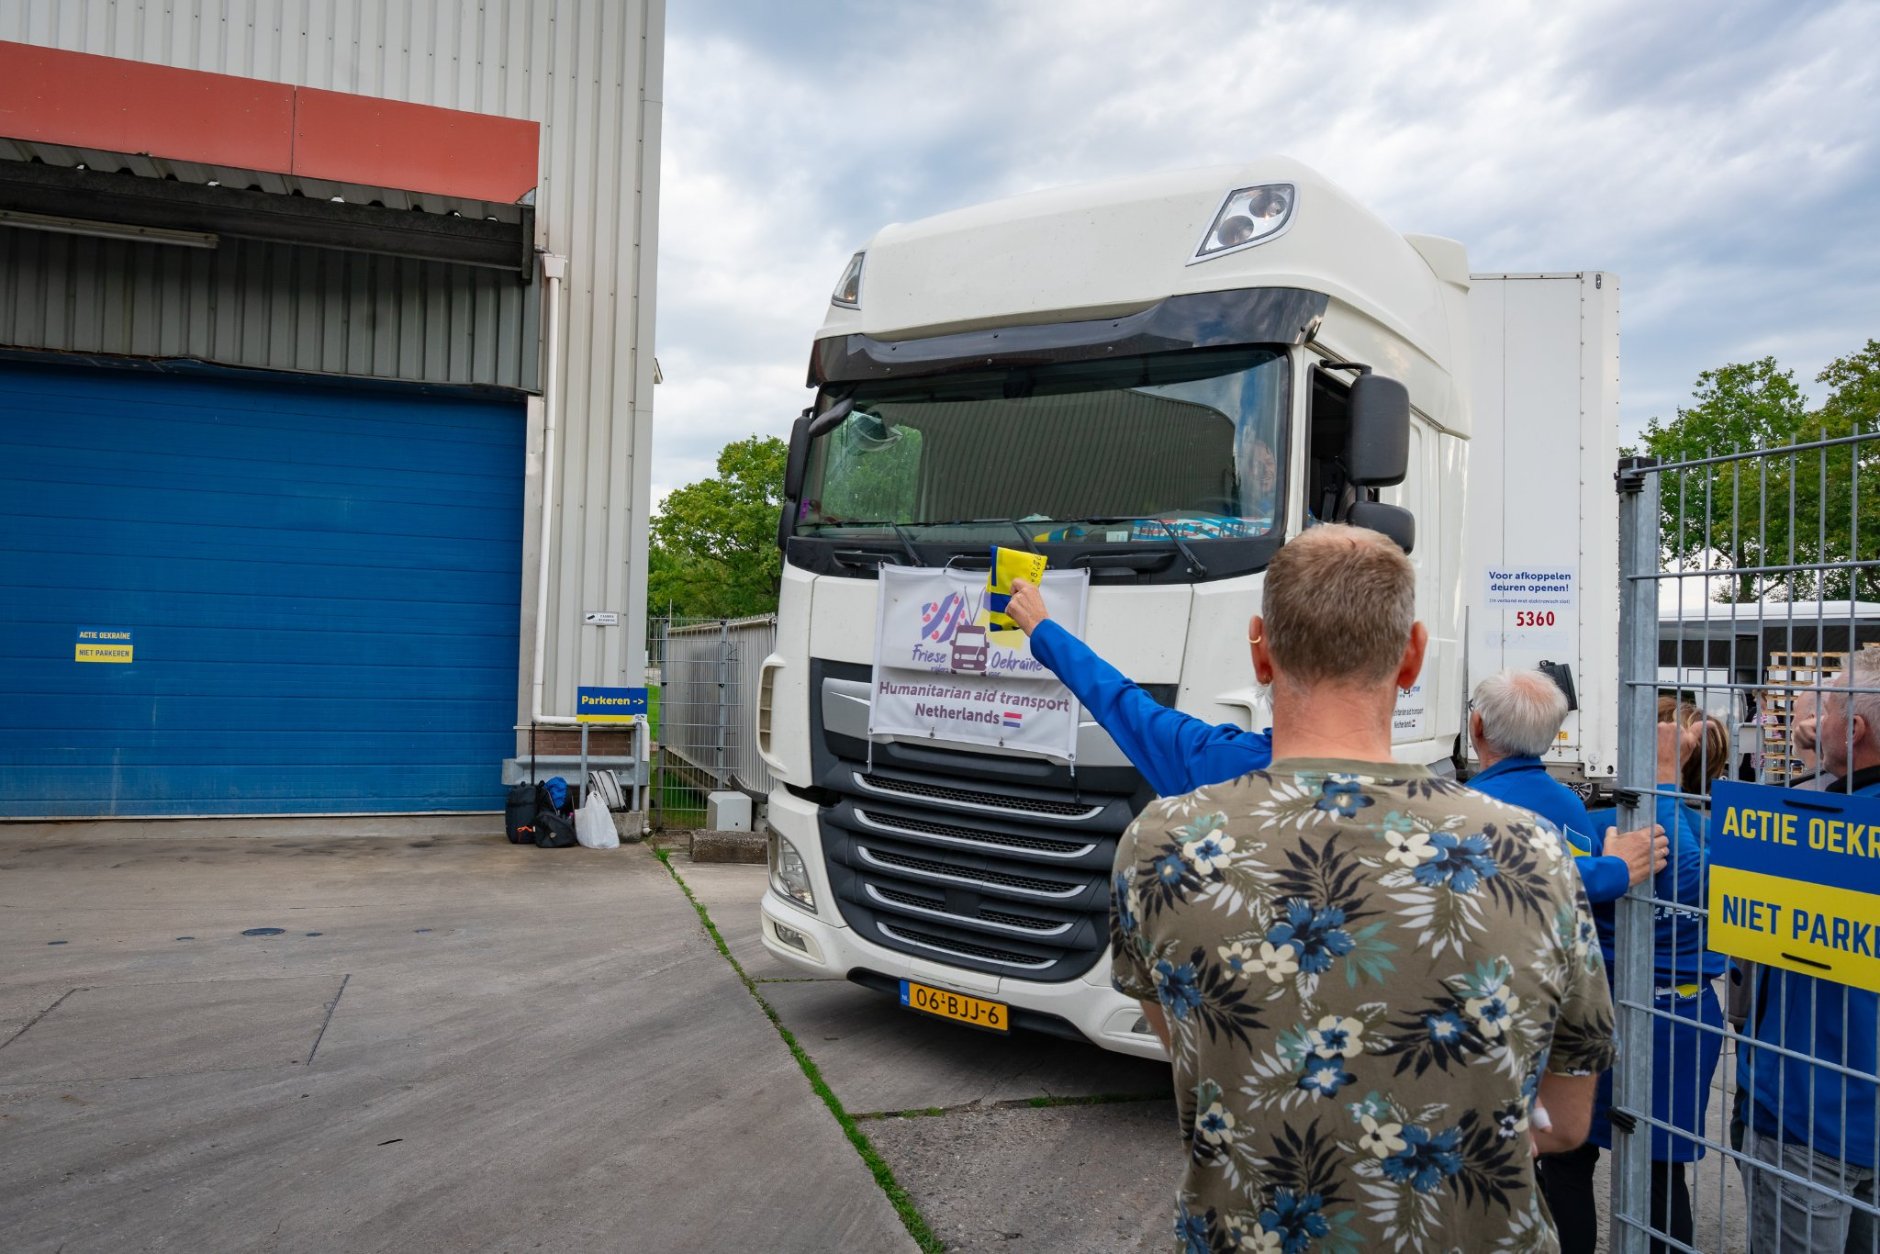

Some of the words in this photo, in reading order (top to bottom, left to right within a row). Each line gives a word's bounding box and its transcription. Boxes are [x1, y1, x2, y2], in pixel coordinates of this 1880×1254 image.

[1489, 571, 1513, 580] Voor
[1515, 572, 1571, 581] afkoppelen
[1528, 584, 1569, 593] openen!
[1516, 611, 1555, 626] 5360
[79, 631, 97, 639] ACTIE
[95, 649, 130, 657] PARKEREN
[912, 643, 947, 663] Friese
[990, 650, 1042, 672] Oekraïne
[581, 695, 631, 705] Parkeren
[879, 681, 971, 700] Humanitarian
[974, 690, 997, 703] aid
[1000, 691, 1070, 713] transport
[915, 702, 1000, 725] Netherlands
[1722, 806, 1798, 846] ACTIE
[1808, 818, 1880, 859] OEKR
[1722, 894, 1782, 935] NIET
[916, 988, 999, 1025] 06-BJJ-6
